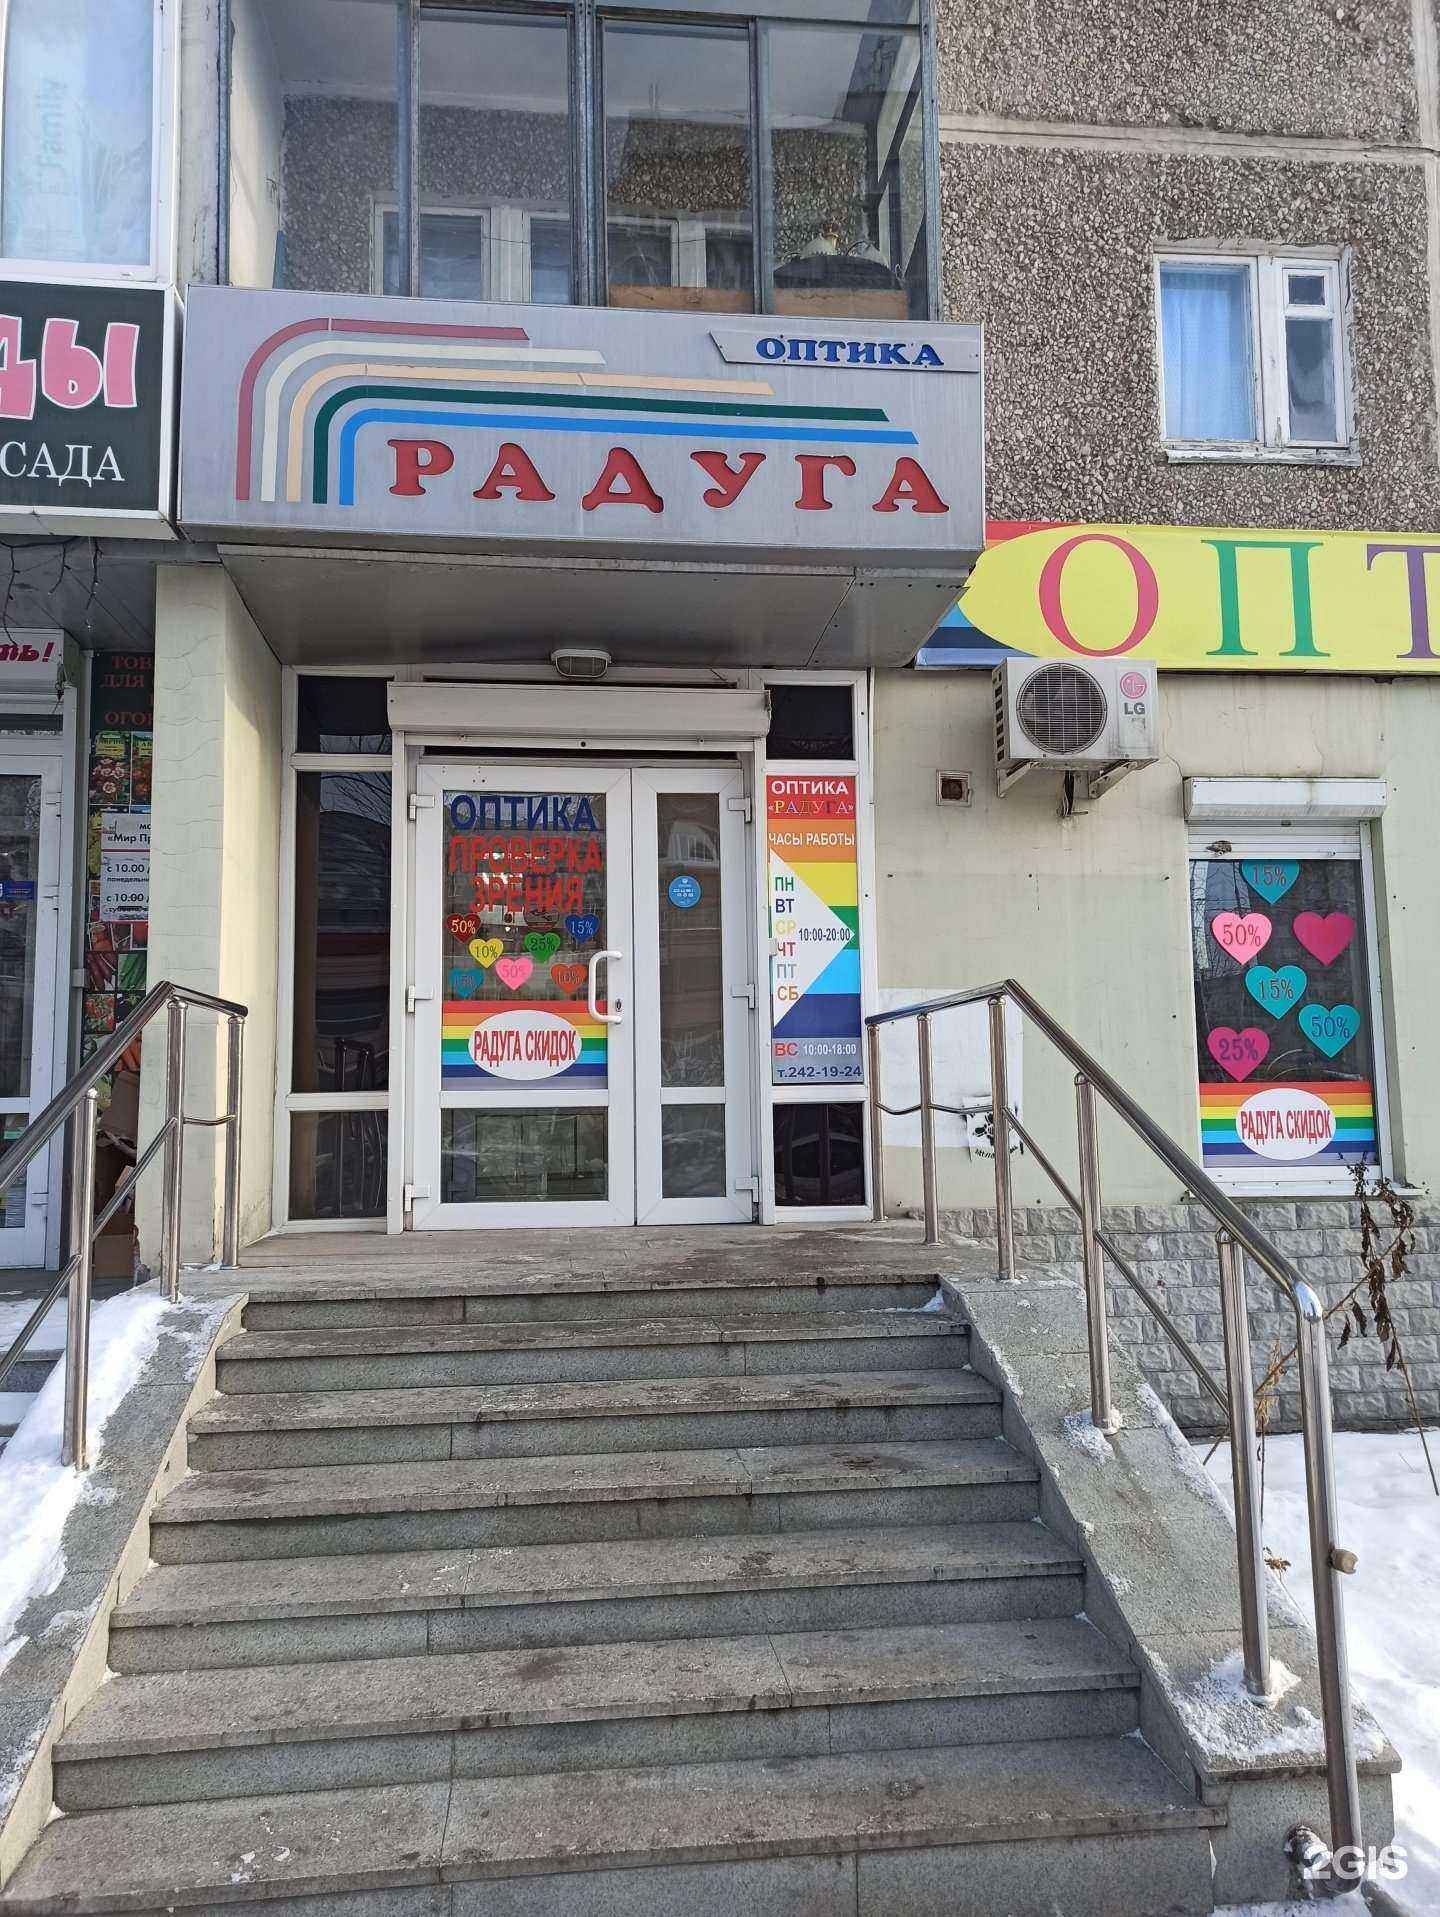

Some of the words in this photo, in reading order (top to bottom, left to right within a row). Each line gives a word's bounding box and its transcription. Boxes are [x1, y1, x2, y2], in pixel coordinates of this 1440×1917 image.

[755, 336, 944, 367] ОПТИКА
[0, 441, 125, 487] САДА
[387, 439, 950, 513] РАДУГА
[1039, 533, 1440, 659] ОПТ
[1124, 702, 1145, 715] LG
[771, 780, 849, 795] ОПТИКА
[450, 794, 597, 831] ОПТИКА
[769, 832, 802, 846] ЧАСЫ
[806, 832, 855, 846] РАБОТЫ
[450, 834, 603, 874] ПРОВЕРКА
[775, 876, 794, 892] ПН
[1252, 865, 1287, 886] 15%
[468, 875, 584, 914] ЗРЕНИЯ
[775, 898, 795, 913] ВТ
[451, 919, 476, 935] 50%
[571, 920, 594, 935] 15%
[775, 917, 796, 935] СР
[799, 928, 851, 942] 10:00-20:00
[1223, 924, 1262, 947] 50%
[474, 945, 499, 958] 10%
[530, 938, 556, 951] 25%
[777, 942, 796, 957] ЧТ
[776, 963, 797, 979] ПТ
[777, 985, 799, 1001] СБ
[1259, 978, 1294, 1000] 15%
[1311, 1016, 1350, 1039] 50%
[474, 1030, 522, 1067] РАДУГА
[525, 1030, 577, 1067] СКИДОК
[775, 1042, 799, 1057] ВС
[803, 1044, 857, 1055] 10:00-18:00
[1218, 1038, 1259, 1061] 25%
[777, 1065, 862, 1079] т.242-19-24
[1241, 1110, 1285, 1145] РАДУГА
[1286, 1109, 1332, 1145] СКИДОК
